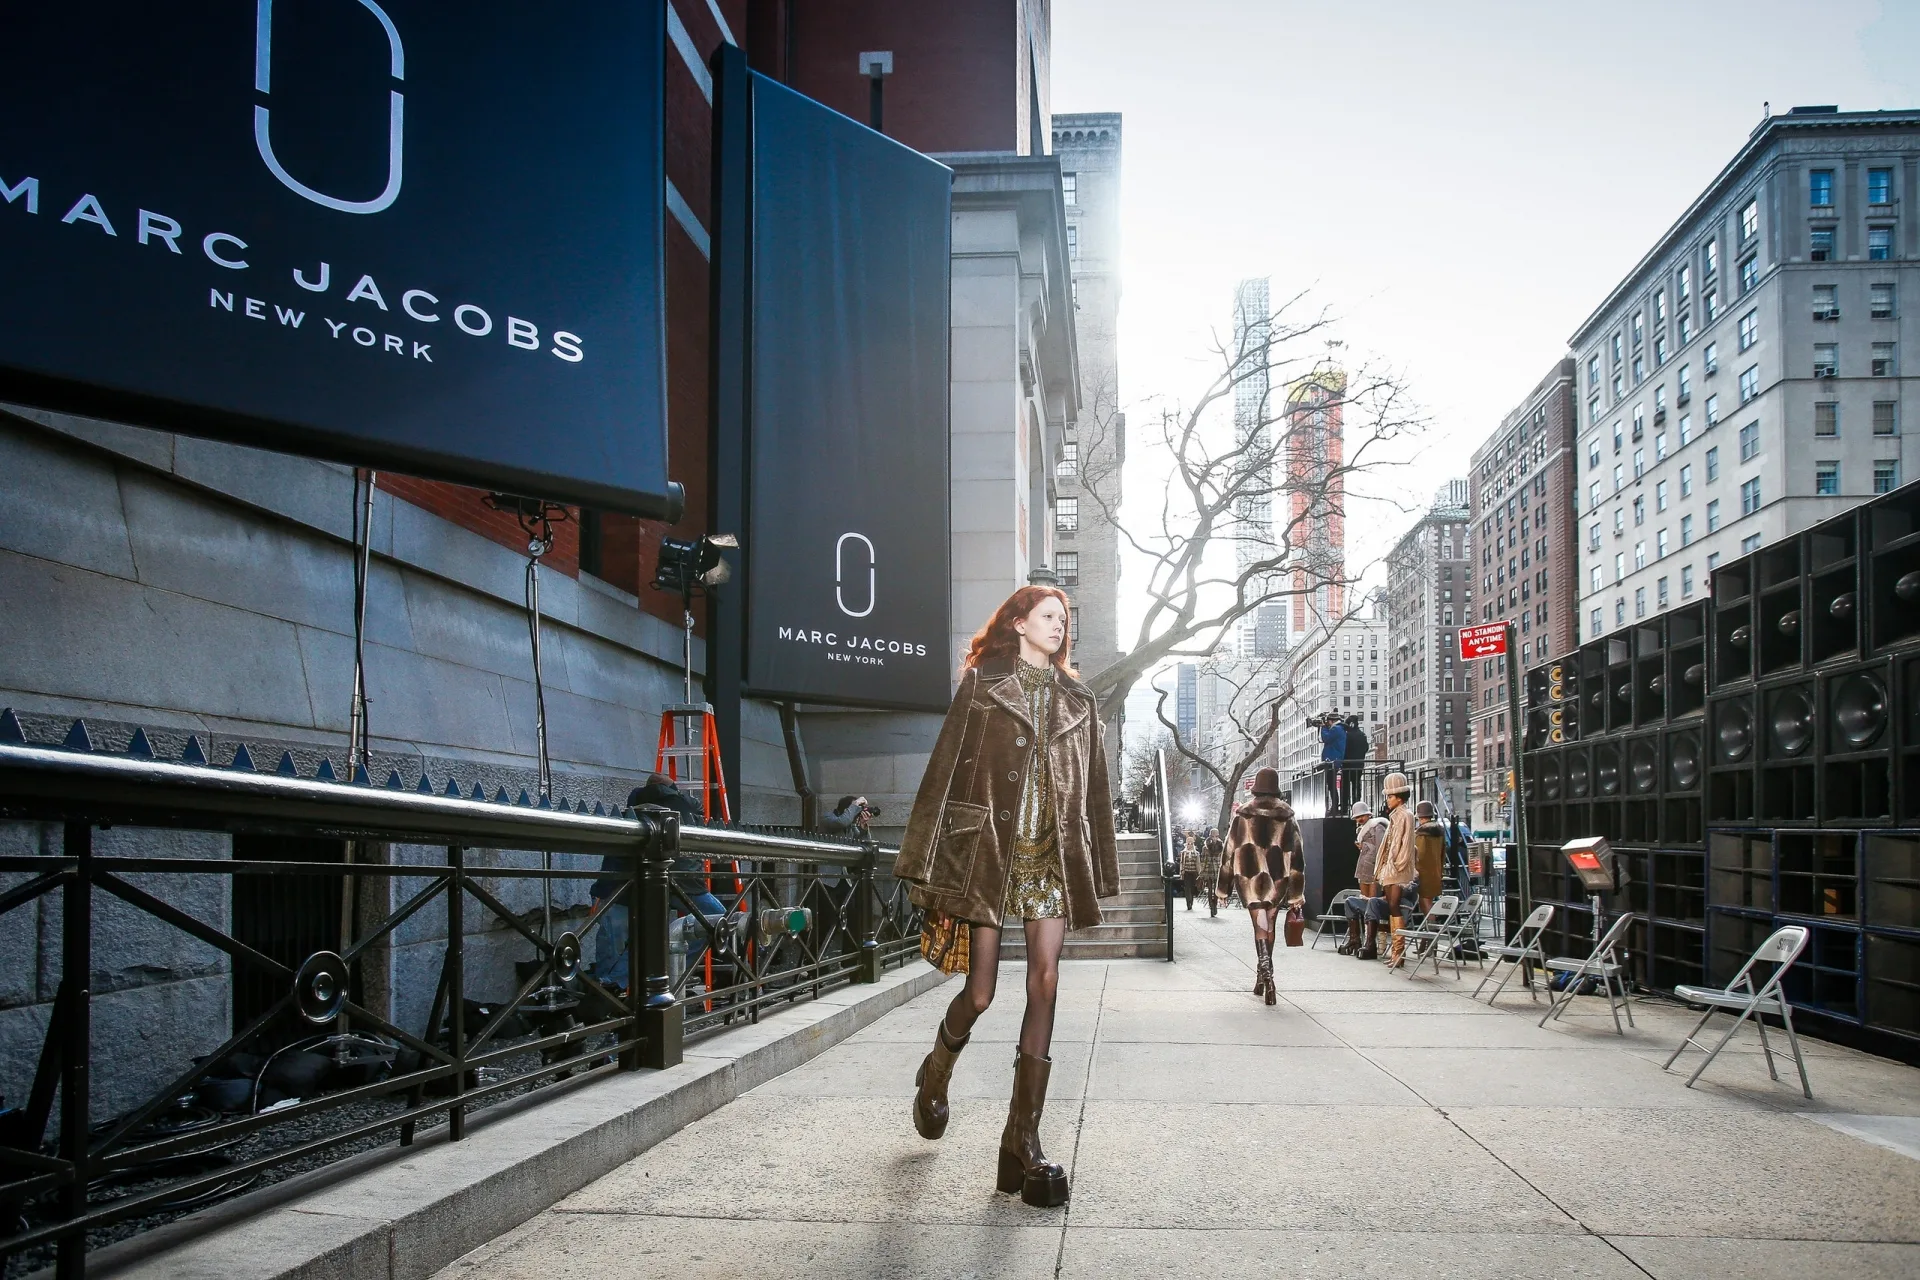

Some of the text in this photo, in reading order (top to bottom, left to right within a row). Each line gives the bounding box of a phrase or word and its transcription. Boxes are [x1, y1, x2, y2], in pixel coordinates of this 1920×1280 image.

[0, 176, 584, 363] MARC JACOBS
[211, 288, 433, 363] NEW YORK
[779, 626, 927, 657] MARC JACOBS
[1462, 630, 1472, 639] NO
[1468, 633, 1504, 646] ANYTIME
[827, 652, 884, 666] NEW YORK
